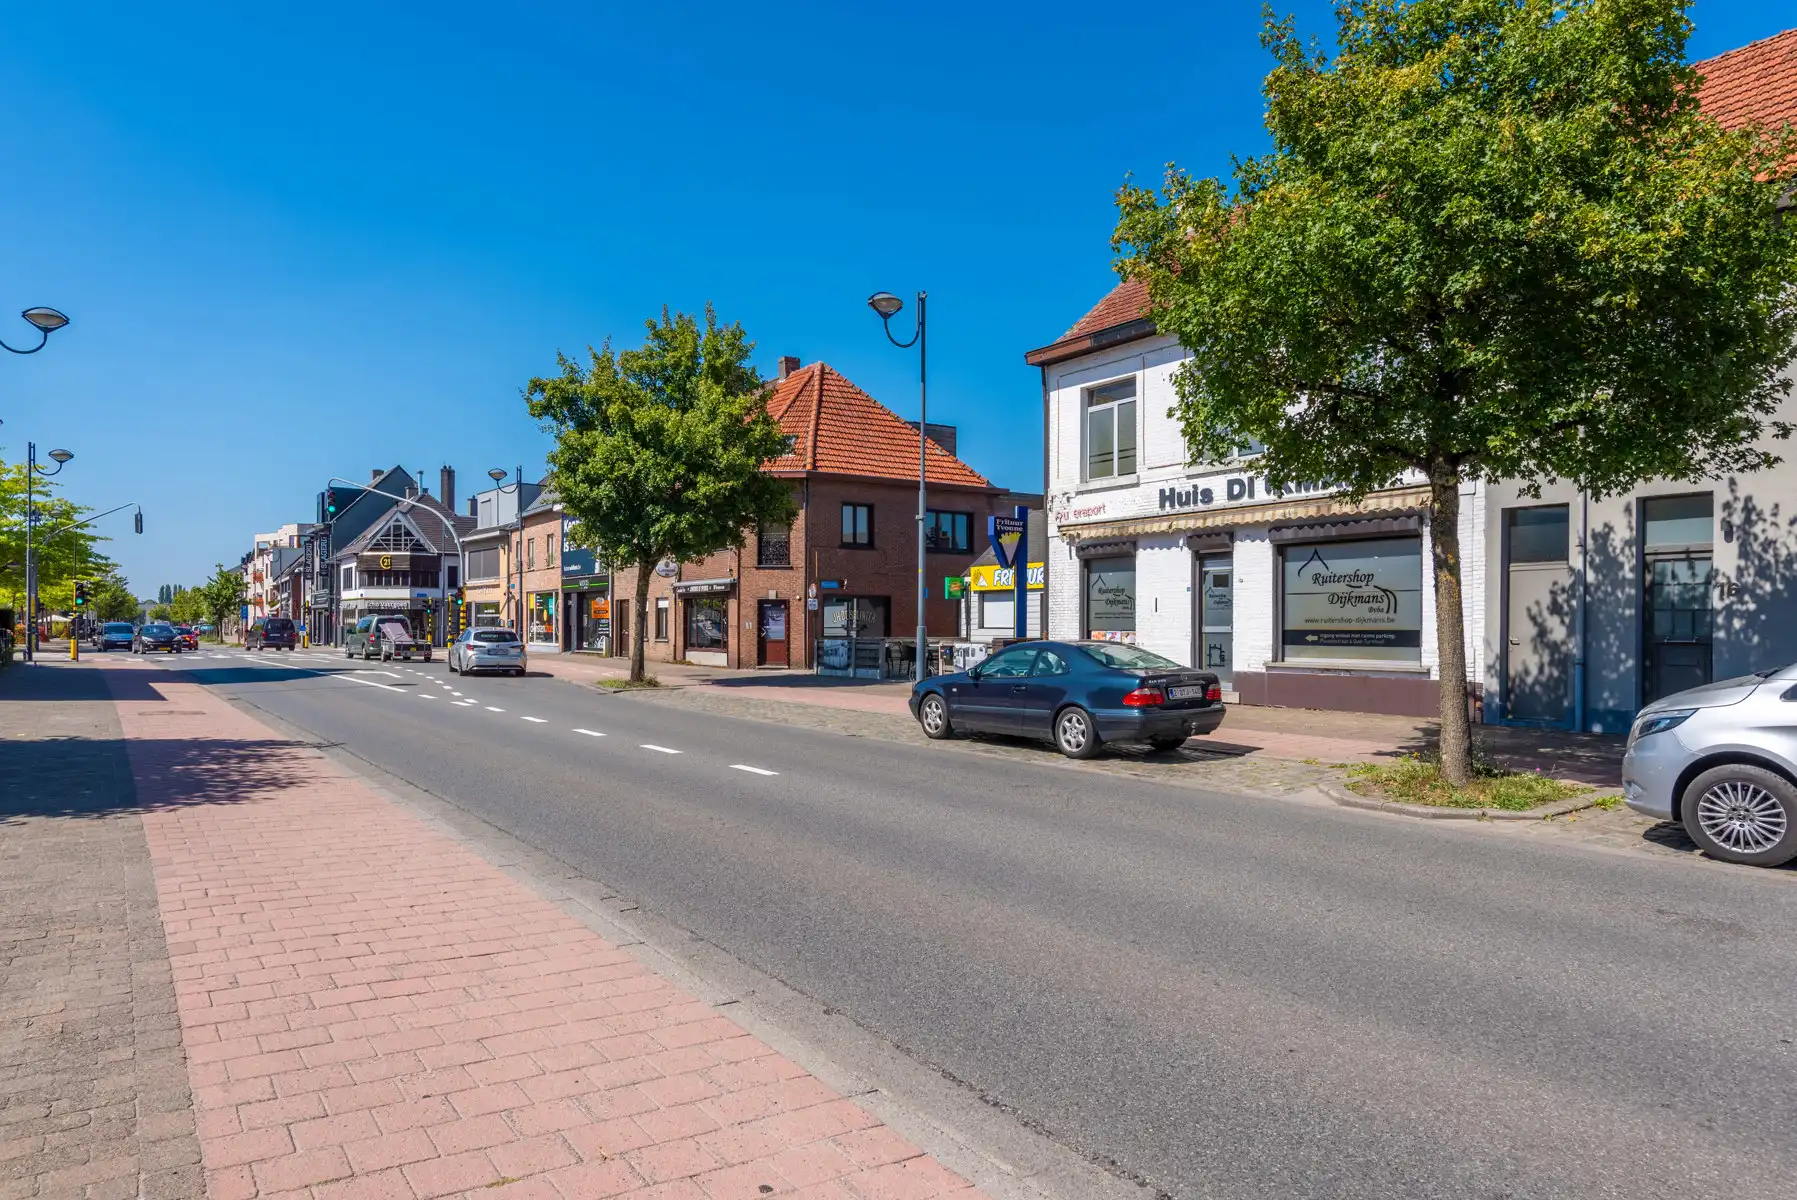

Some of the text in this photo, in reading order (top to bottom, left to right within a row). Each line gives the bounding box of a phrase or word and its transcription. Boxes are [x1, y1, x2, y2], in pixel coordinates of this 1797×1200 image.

[1159, 484, 1214, 509] Huis
[996, 518, 1024, 526] Frituur
[996, 524, 1023, 532] Yvonne
[1312, 569, 1374, 586] Ruitershop
[1328, 591, 1385, 608] Dijkmans
